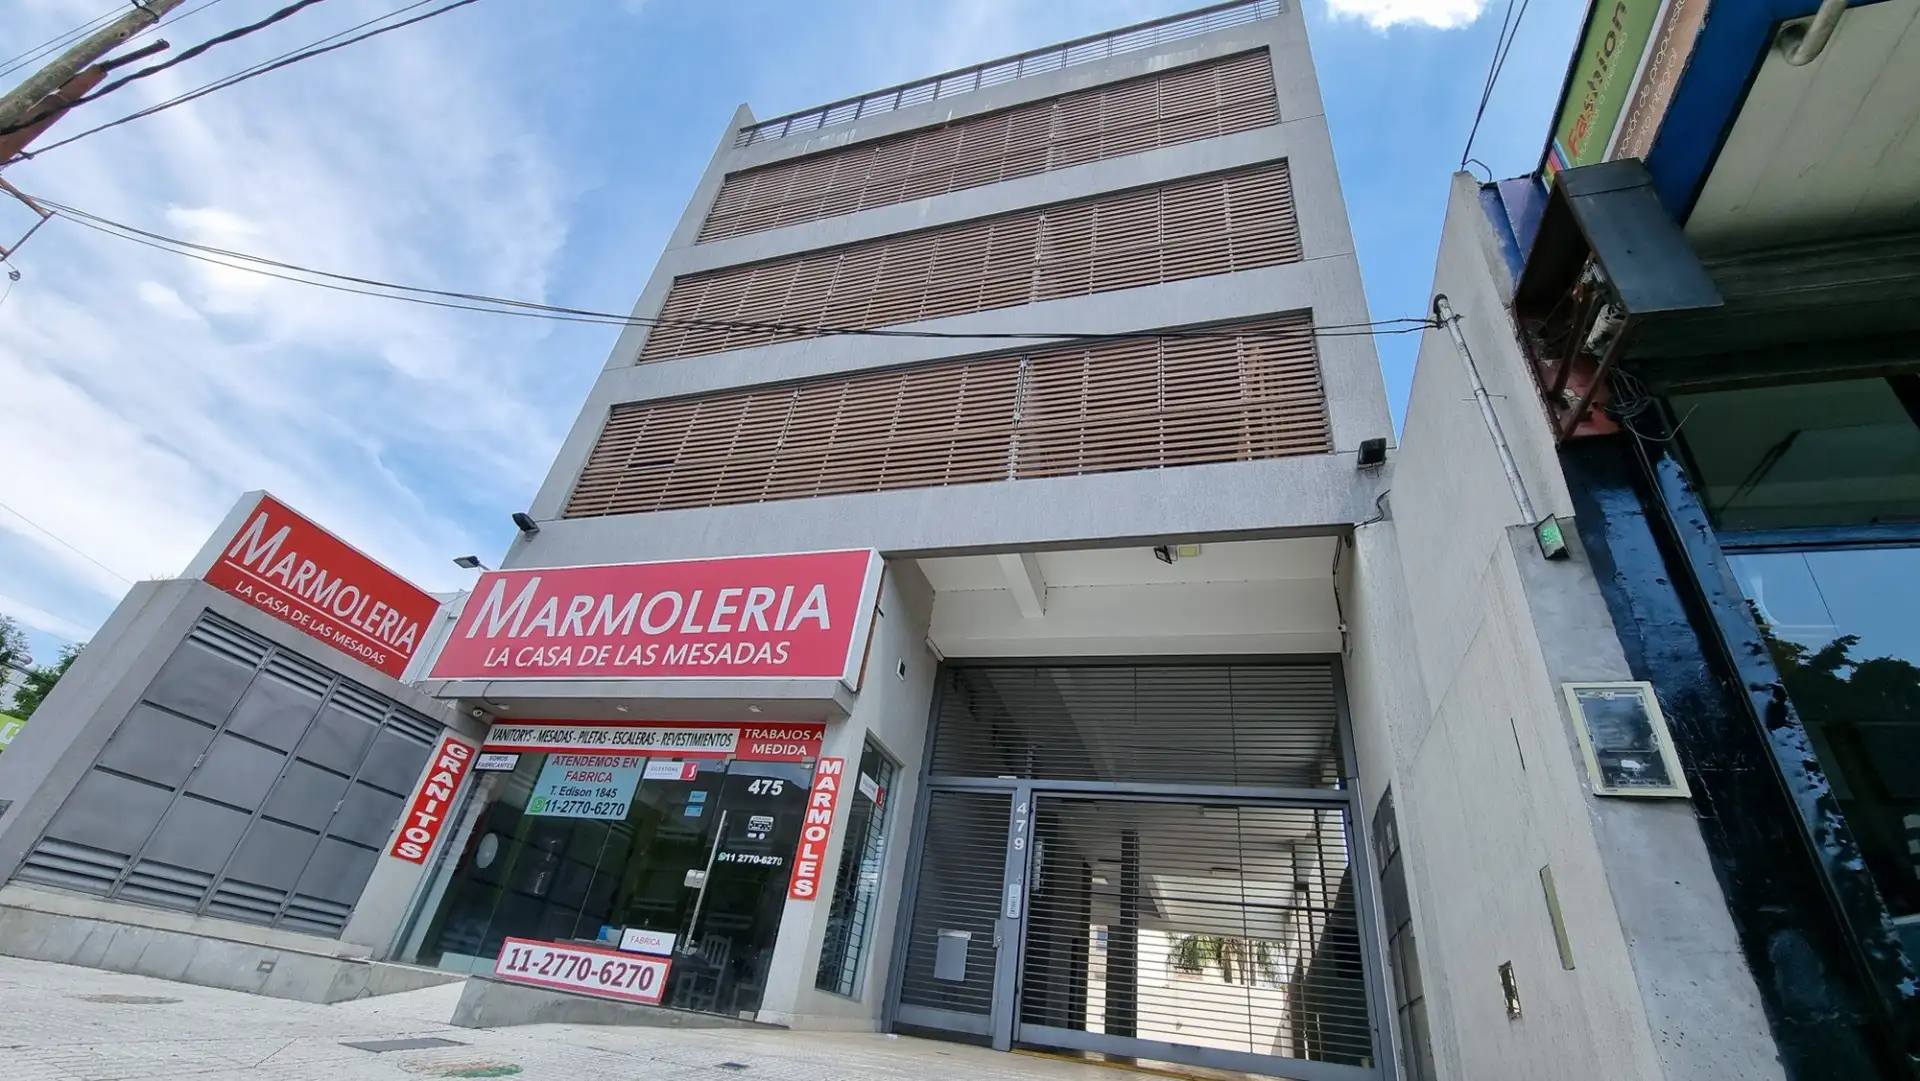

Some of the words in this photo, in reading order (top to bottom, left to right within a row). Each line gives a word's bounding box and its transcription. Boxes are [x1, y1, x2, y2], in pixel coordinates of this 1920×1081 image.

[227, 511, 419, 653] MARMOLERIA
[465, 576, 831, 639] MARMOLERIA
[235, 580, 252, 597] LA
[255, 591, 289, 617] CASA
[290, 609, 310, 626] DE
[310, 619, 333, 637] LAS
[333, 631, 387, 666] MESADAS
[484, 647, 508, 667] LA
[514, 645, 572, 667] CASA
[576, 644, 611, 666] DE
[614, 643, 659, 666] LAS
[662, 641, 791, 665] MESADAS
[491, 729, 533, 742] VANITORYS
[537, 729, 573, 743] MESADAS
[578, 731, 607, 745] PILETAS
[612, 732, 656, 746] ESCALERAS
[660, 732, 733, 747] REVESTIMIENTOS
[745, 729, 811, 741] TRABAJOS
[813, 730, 824, 741] A
[751, 744, 808, 756] MEDIDA
[552, 756, 621, 768] ATENDEMOS
[622, 757, 640, 768] EN
[564, 771, 613, 784] FABRICA
[551, 786, 558, 796] T.
[558, 786, 592, 797] Edison
[595, 787, 618, 798] 1845
[748, 779, 784, 796] 475
[397, 743, 469, 859] GRANITOS
[544, 800, 625, 817] 11-2770-6270
[793, 760, 842, 897] MARMOLES
[1014, 802, 1027, 850] 479
[737, 855, 783, 866] 2770-6270
[629, 935, 661, 946] FABRICA
[506, 948, 655, 991] 11-2770-6270
